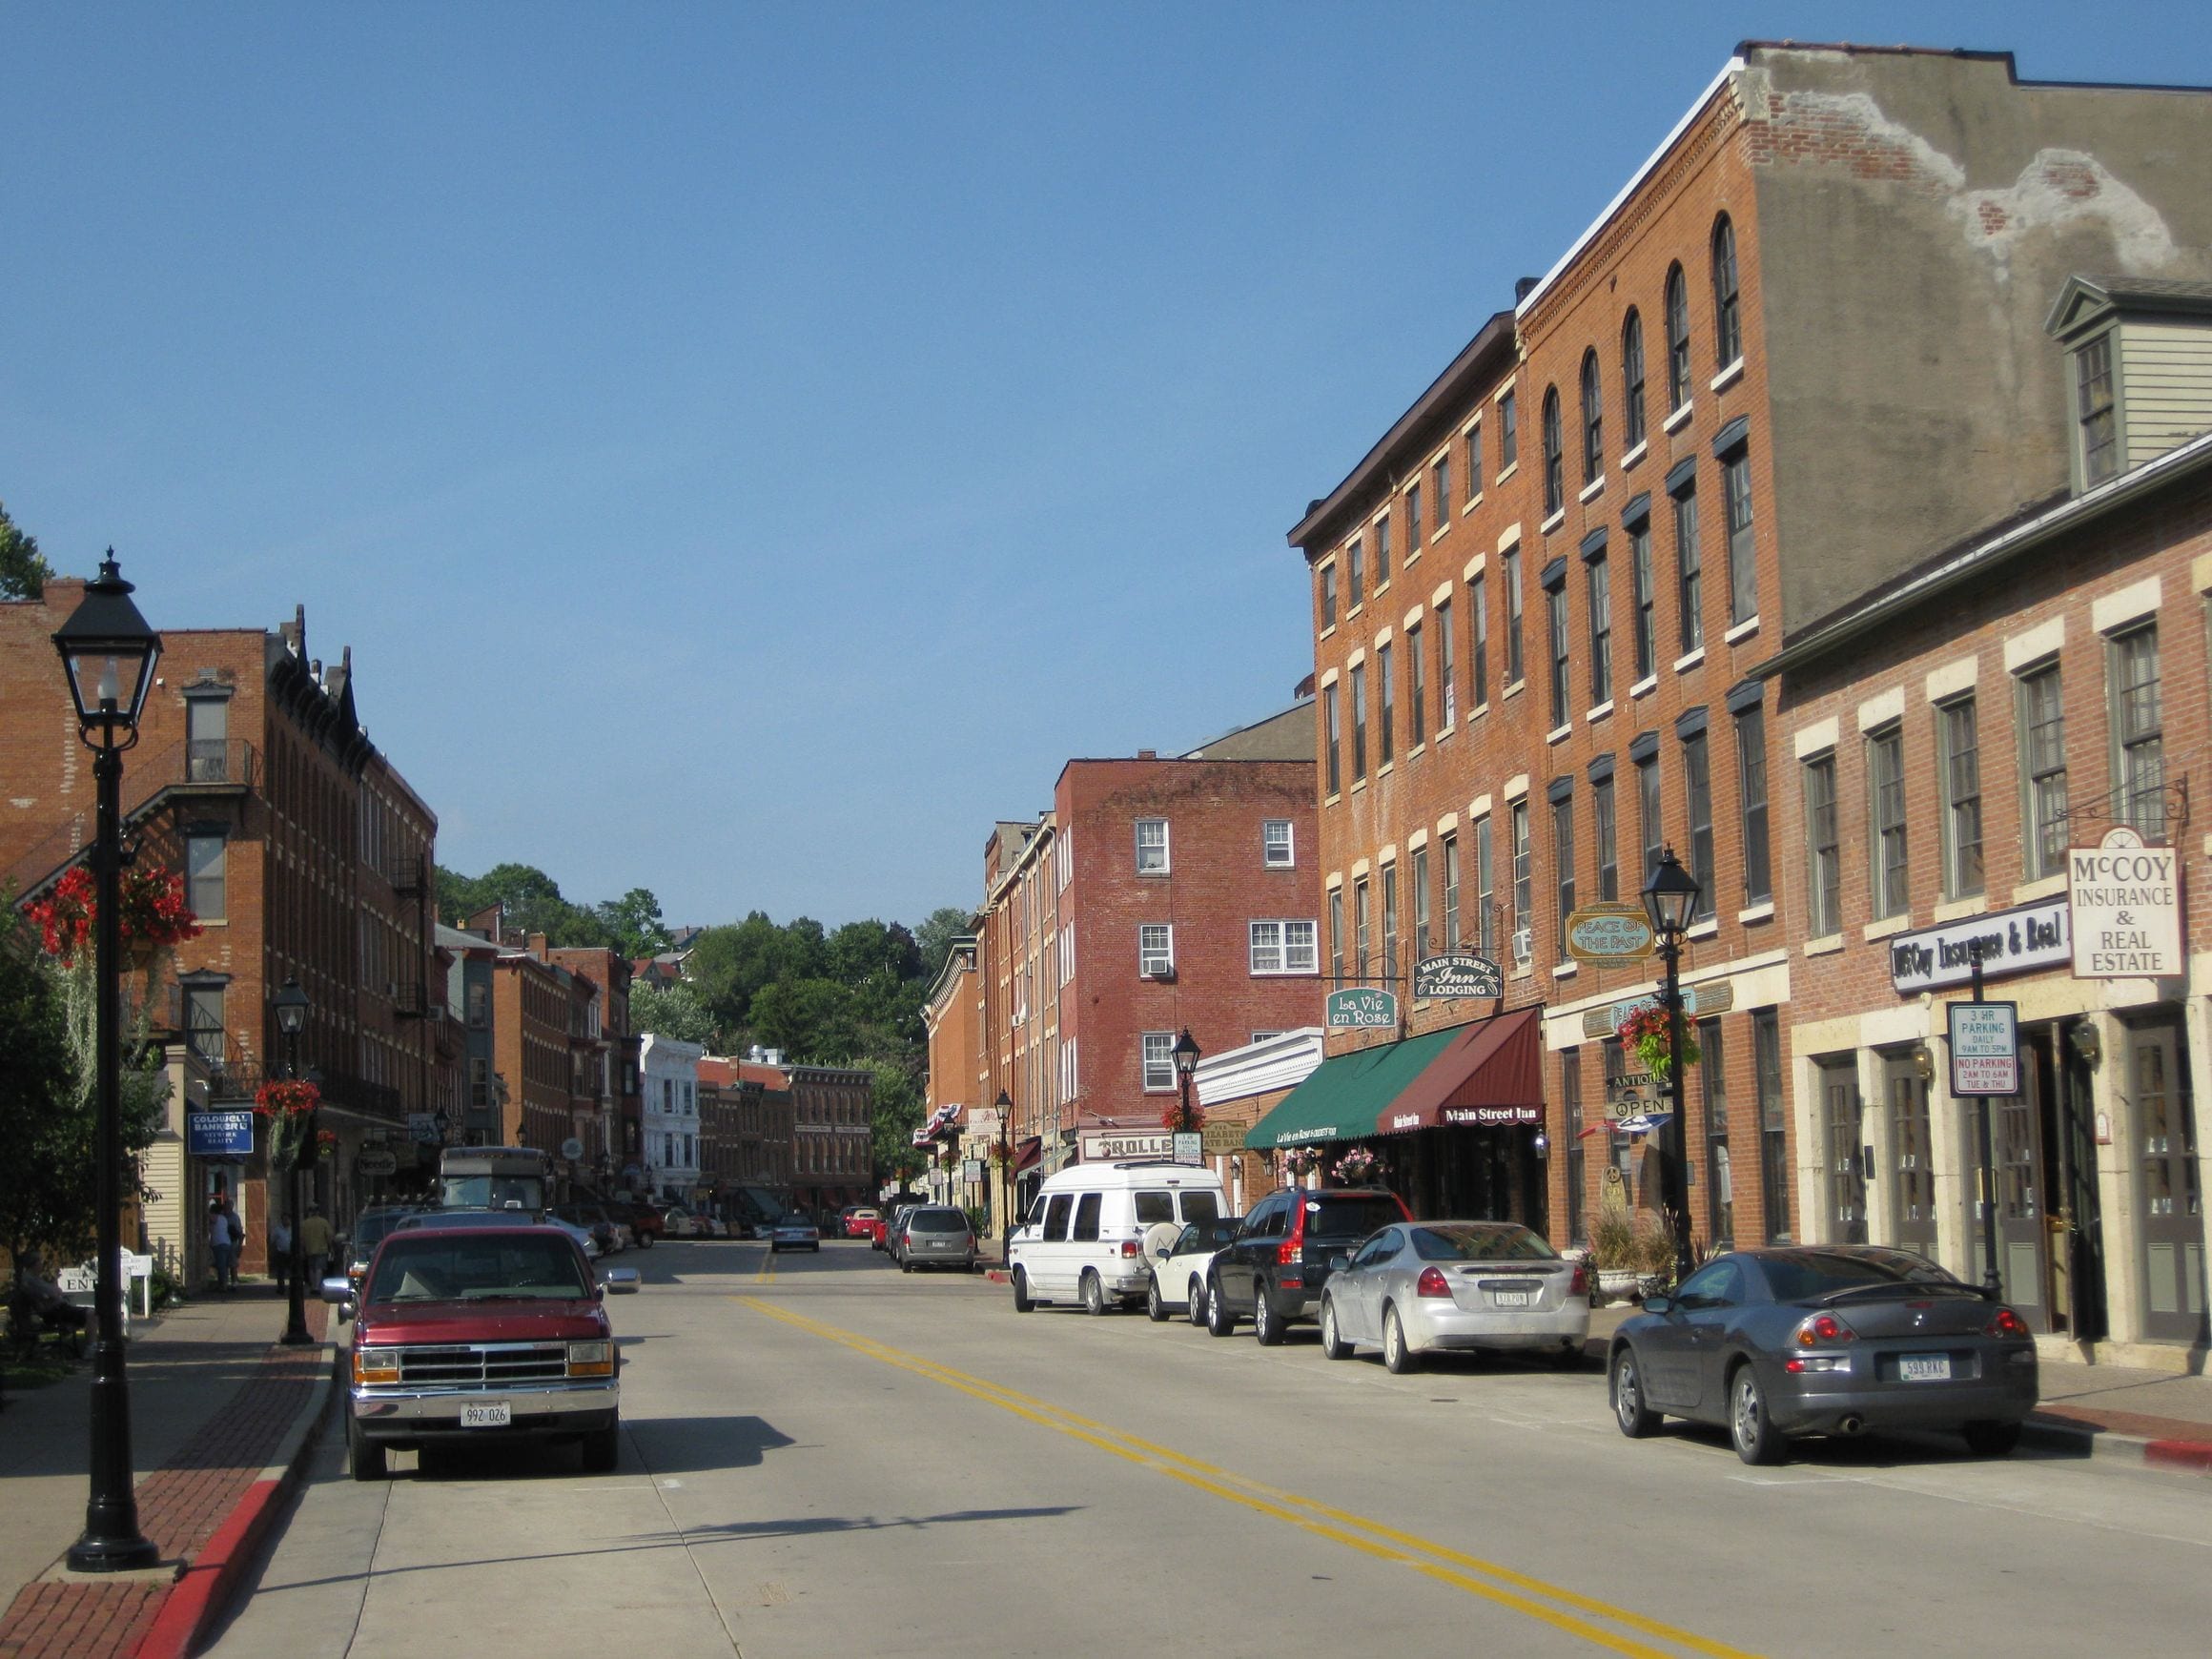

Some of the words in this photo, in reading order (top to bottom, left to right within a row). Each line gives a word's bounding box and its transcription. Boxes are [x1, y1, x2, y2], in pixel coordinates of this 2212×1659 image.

[2074, 856, 2172, 882] McCOY
[2077, 888, 2174, 907] INSURANCE
[2116, 910, 2135, 926] &
[1577, 920, 1621, 933] PEACE
[1623, 919, 1644, 932] OF
[2009, 920, 2022, 955] &
[2026, 911, 2061, 952] Real
[1579, 935, 1608, 950] THE
[1610, 934, 1643, 949] PAST
[2100, 931, 2152, 950] REAL
[1421, 958, 1450, 974] MAIN
[1452, 957, 1494, 974] STREET
[2092, 952, 2163, 971] ESTATE
[1435, 966, 1480, 985] Inn
[1429, 985, 1486, 995] LODGING
[1339, 996, 1357, 1010] La
[1361, 994, 1384, 1011] Vie
[1332, 1013, 1350, 1025] en
[1353, 1010, 1390, 1025] Rose
[1971, 1010, 1977, 1021] 3
[1981, 1010, 1995, 1021] HR
[1961, 1022, 2005, 1034] PARKING
[1973, 1035, 1994, 1044] DAILY
[1961, 1044, 1978, 1054] 9AM
[1980, 1044, 1990, 1054] TO
[1992, 1044, 2007, 1054] 5PM
[1957, 1058, 1971, 1068] NO
[1972, 1058, 2013, 1069] PARKING
[1962, 1070, 1978, 1078] 2AM
[1980, 1070, 1991, 1078] TO
[1993, 1070, 2008, 1078] 6AM
[1966, 1080, 1980, 1089] TUE
[1991, 1079, 2006, 1088] THU
[1445, 1108, 1477, 1122] Main
[1479, 1108, 1513, 1121] Street
[1516, 1107, 1537, 1119] Inn
[1616, 1098, 1665, 1116] OPEN
[1907, 1361, 1924, 1374] 599
[467, 1408, 483, 1422] 992
[489, 1408, 505, 1422] 026
